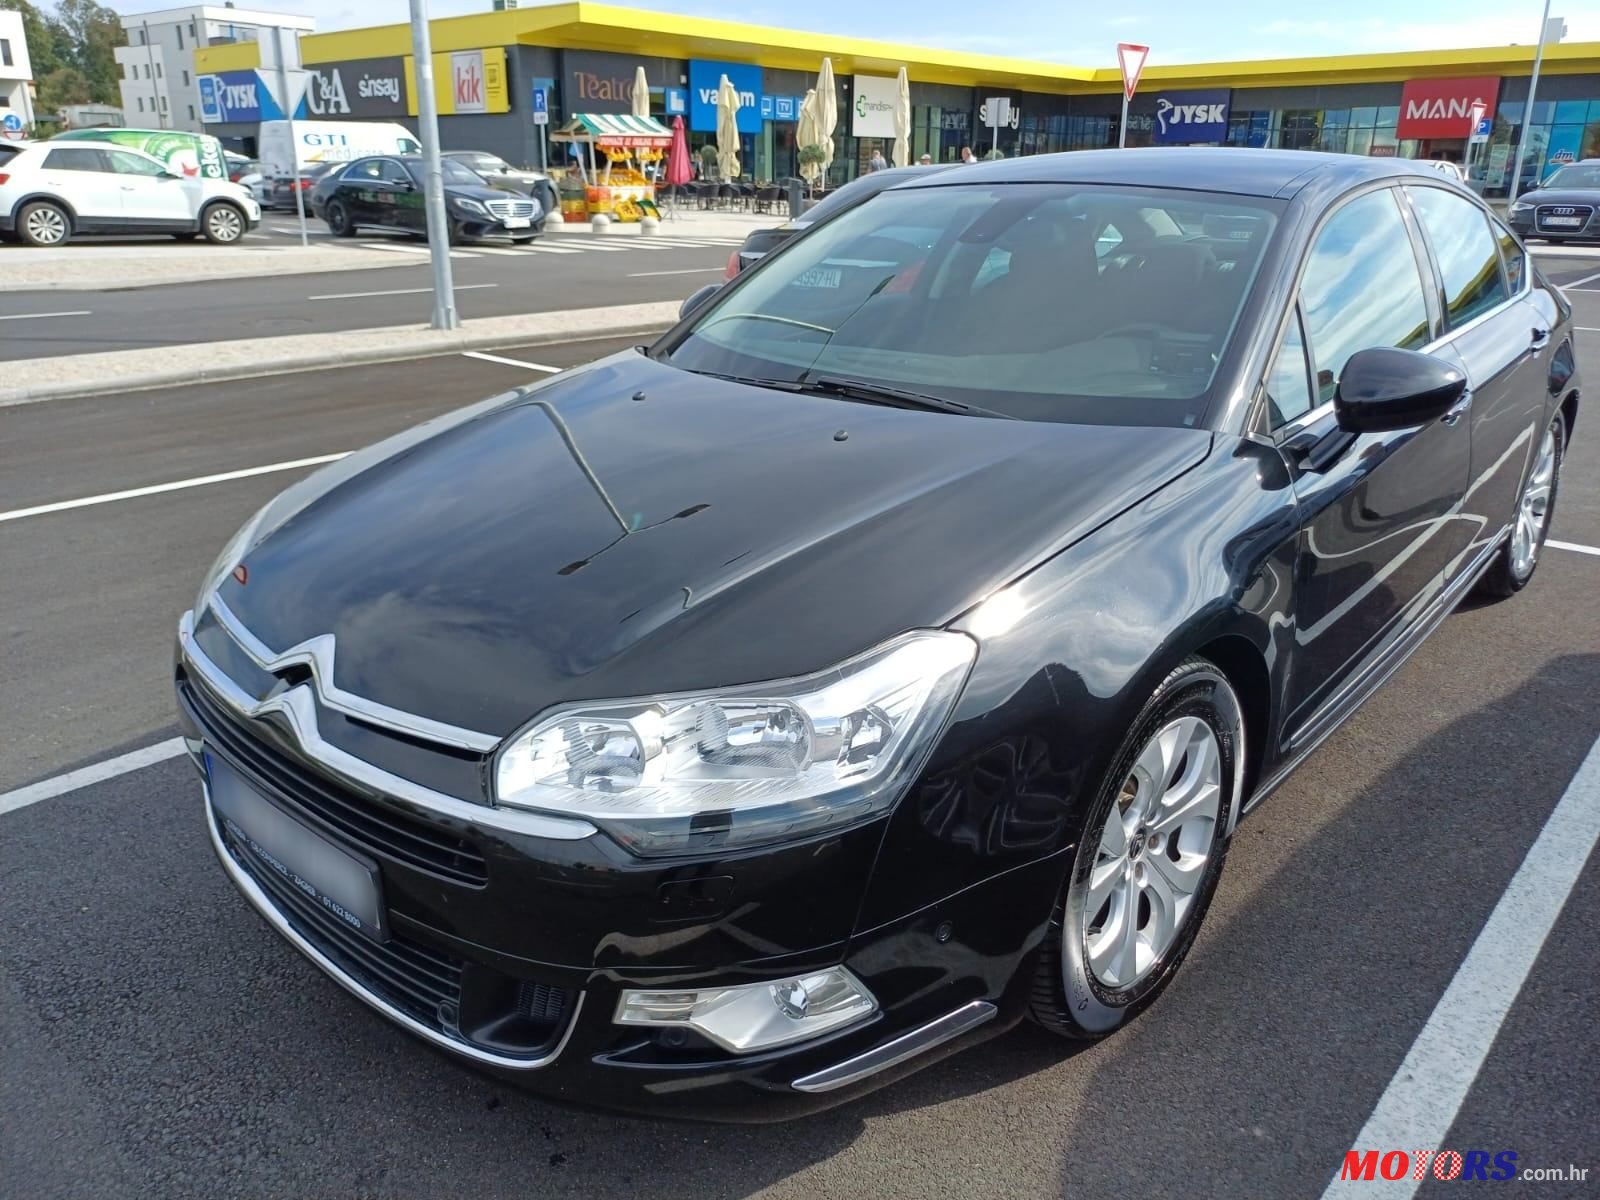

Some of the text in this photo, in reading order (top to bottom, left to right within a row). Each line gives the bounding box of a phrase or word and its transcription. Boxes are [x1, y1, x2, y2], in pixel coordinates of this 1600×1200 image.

[306, 68, 351, 114] C&A
[358, 73, 400, 103] sinsay
[457, 62, 480, 104] kik
[226, 84, 258, 109] JYSK
[698, 88, 755, 107] vam
[1169, 104, 1226, 124] JYSK
[303, 134, 347, 146] GTI
